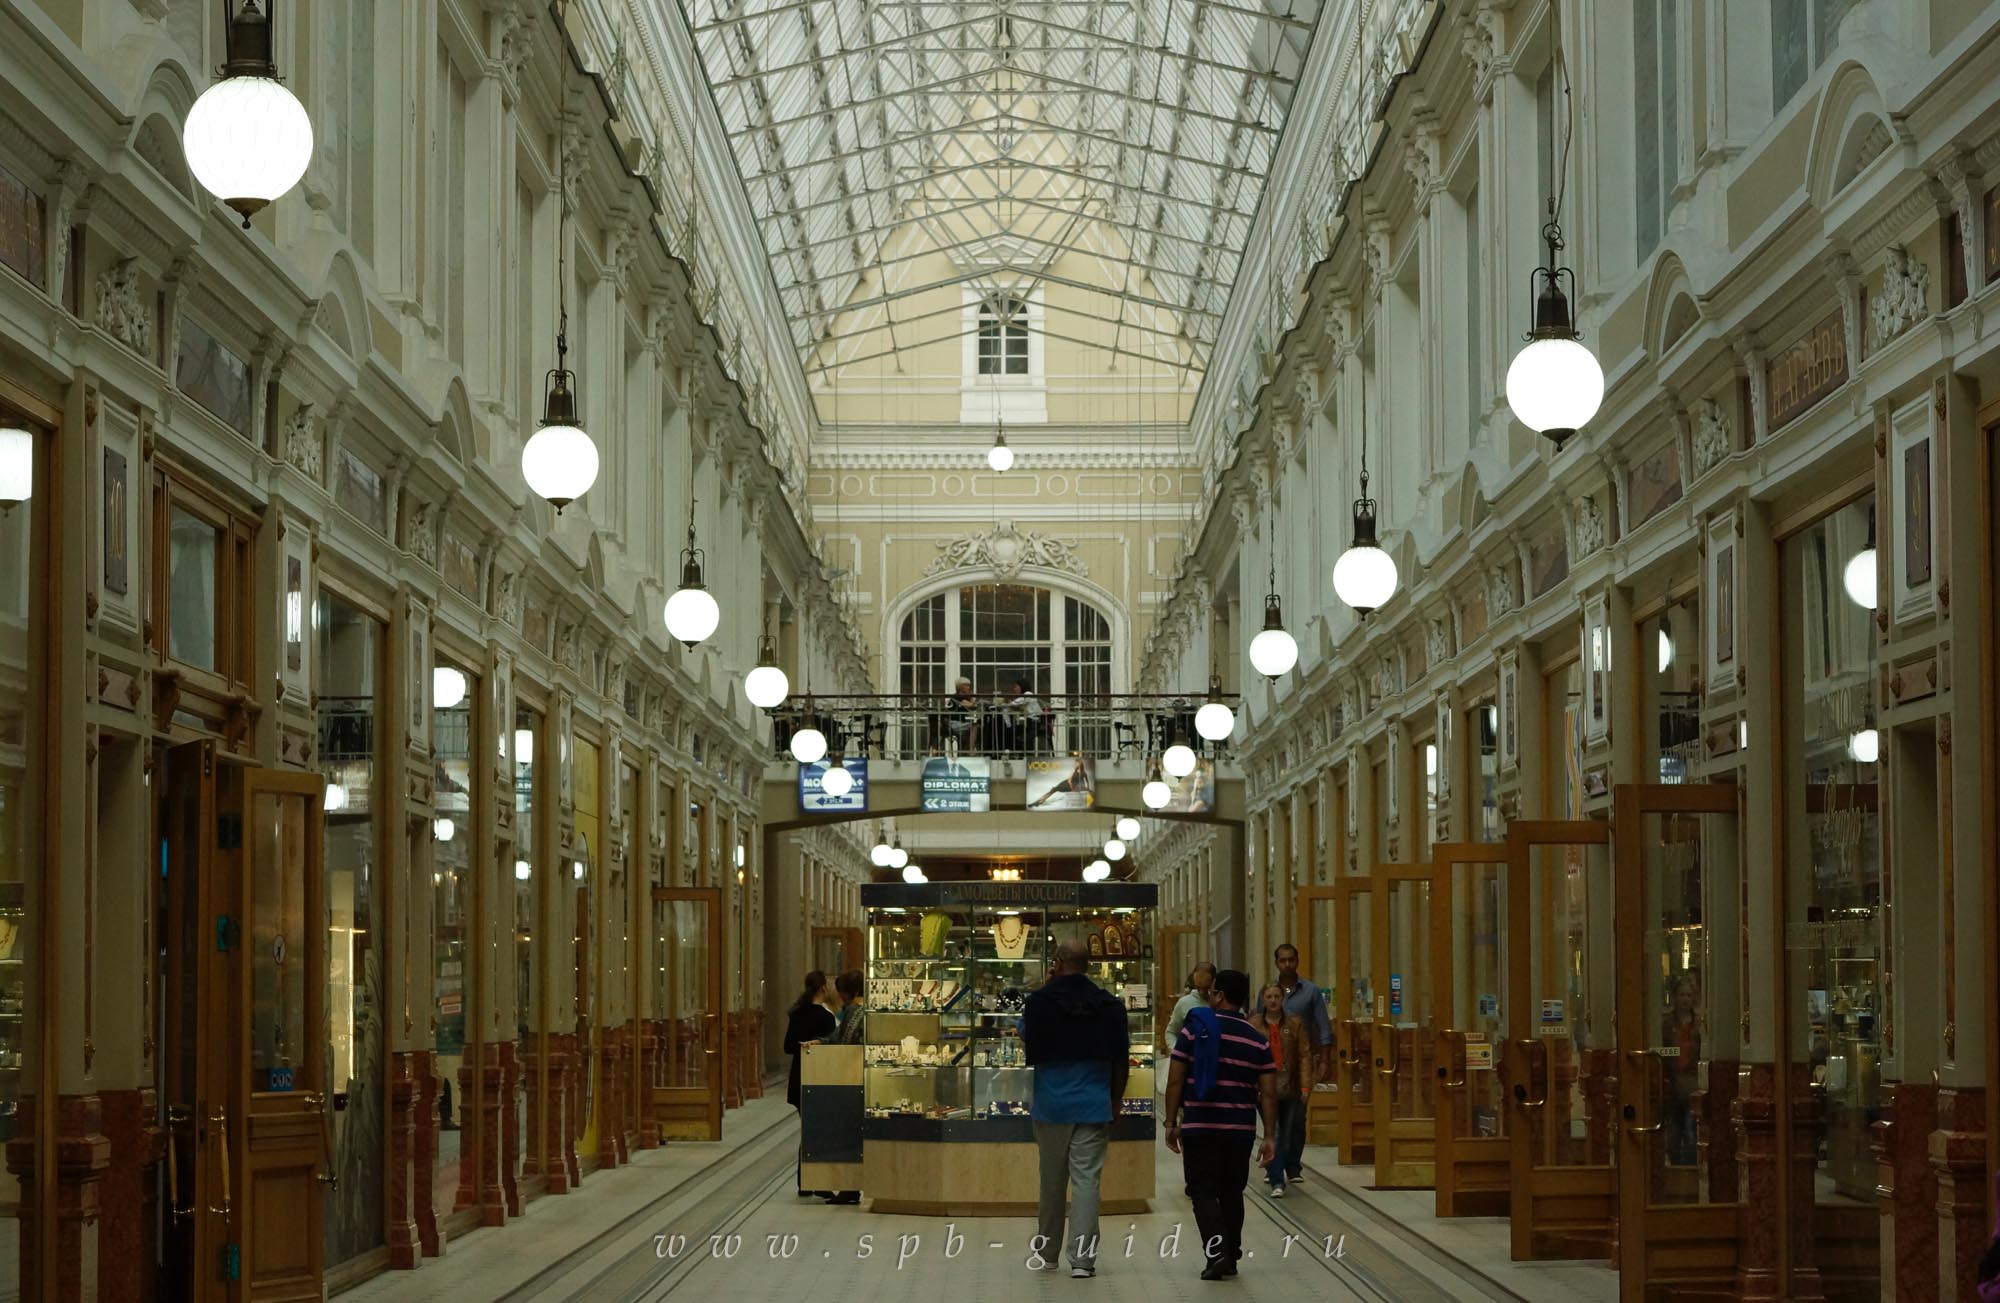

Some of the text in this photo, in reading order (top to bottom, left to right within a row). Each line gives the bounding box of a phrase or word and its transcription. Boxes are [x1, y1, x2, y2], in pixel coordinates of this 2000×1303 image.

[924, 781, 988, 789] DIPLOMAT
[940, 799, 947, 807] 2
[1024, 885, 1072, 901] РОССИИ
